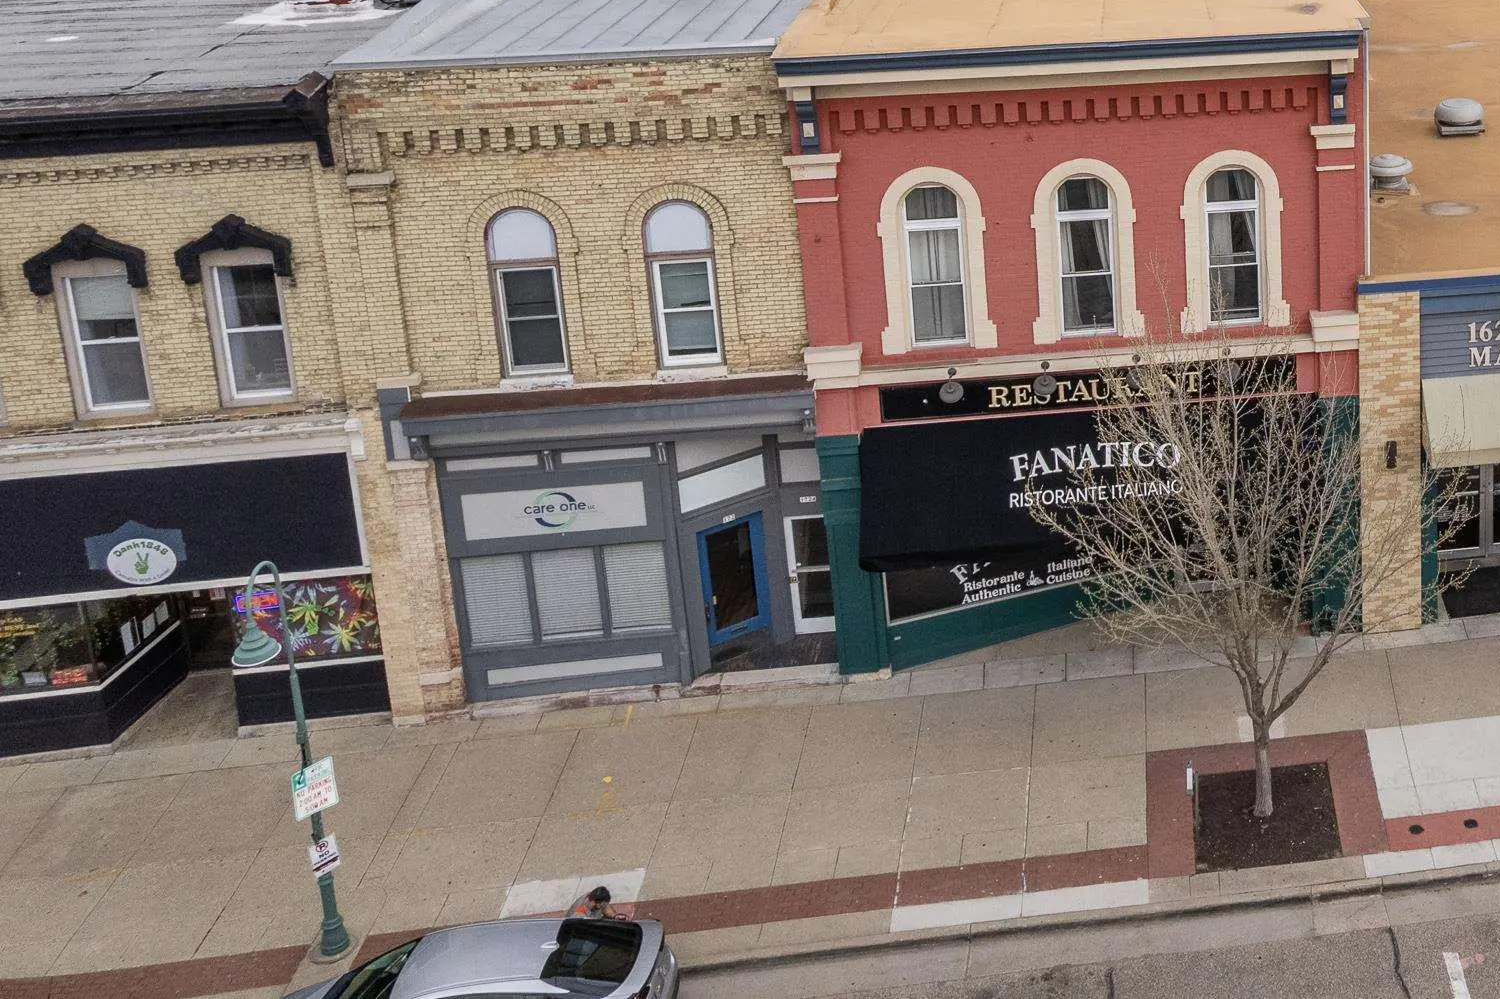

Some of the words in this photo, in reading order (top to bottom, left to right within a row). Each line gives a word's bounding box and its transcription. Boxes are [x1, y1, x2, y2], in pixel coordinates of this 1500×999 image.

[988, 371, 1201, 408] RETAURNT
[1009, 441, 1181, 482] FANATICO
[523, 504, 555, 515] care
[559, 501, 587, 512] one
[1009, 484, 1108, 509] RISTORANTE
[1110, 479, 1183, 500] ITALIANO
[961, 582, 1022, 605] Authentic
[1046, 567, 1091, 585] Cuisine
[963, 570, 1025, 592] Ristorante
[1047, 555, 1093, 574] Italiano
[319, 850, 329, 858] NO
